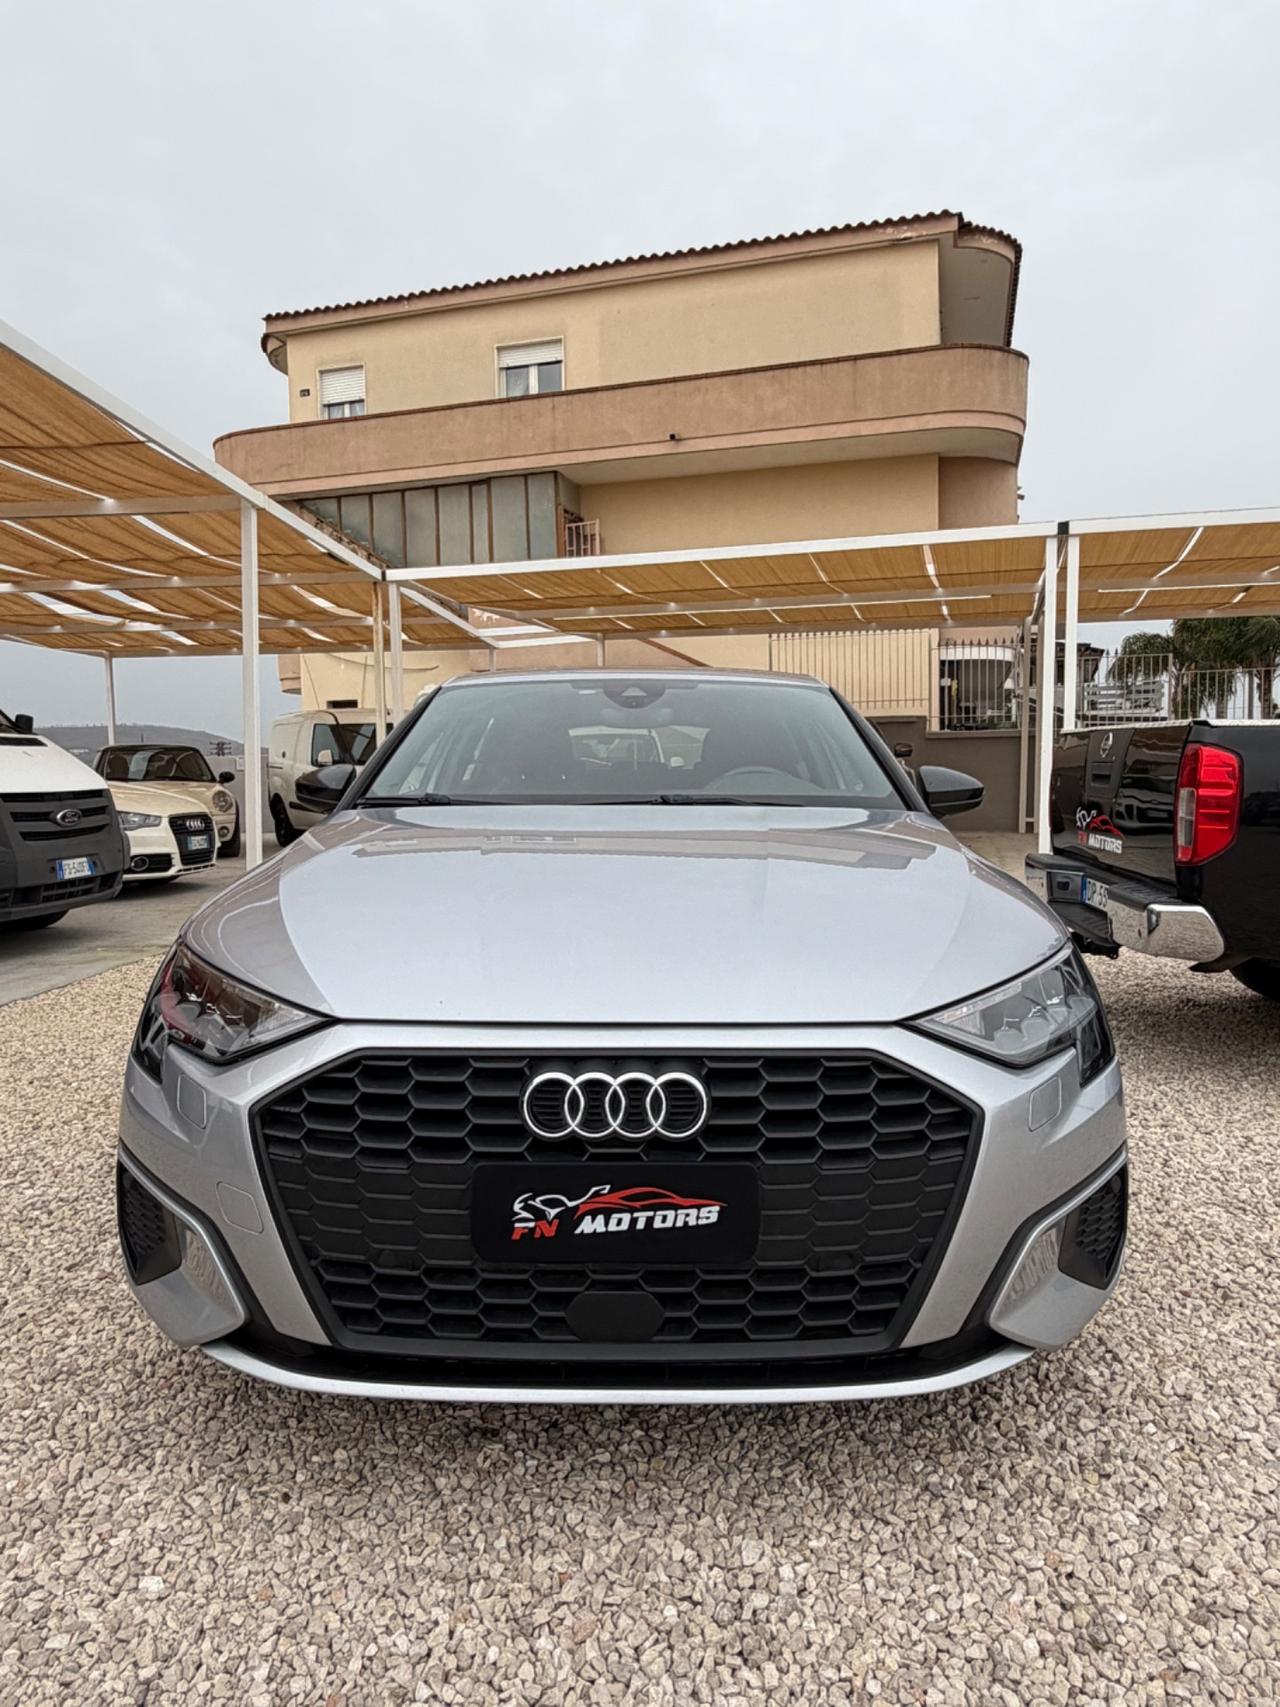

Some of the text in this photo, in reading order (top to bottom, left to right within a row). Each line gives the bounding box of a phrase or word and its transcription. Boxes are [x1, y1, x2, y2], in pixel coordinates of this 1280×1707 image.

[1088, 833, 1122, 854] MOTORS
[512, 1206, 721, 1240] FN MOTORS
